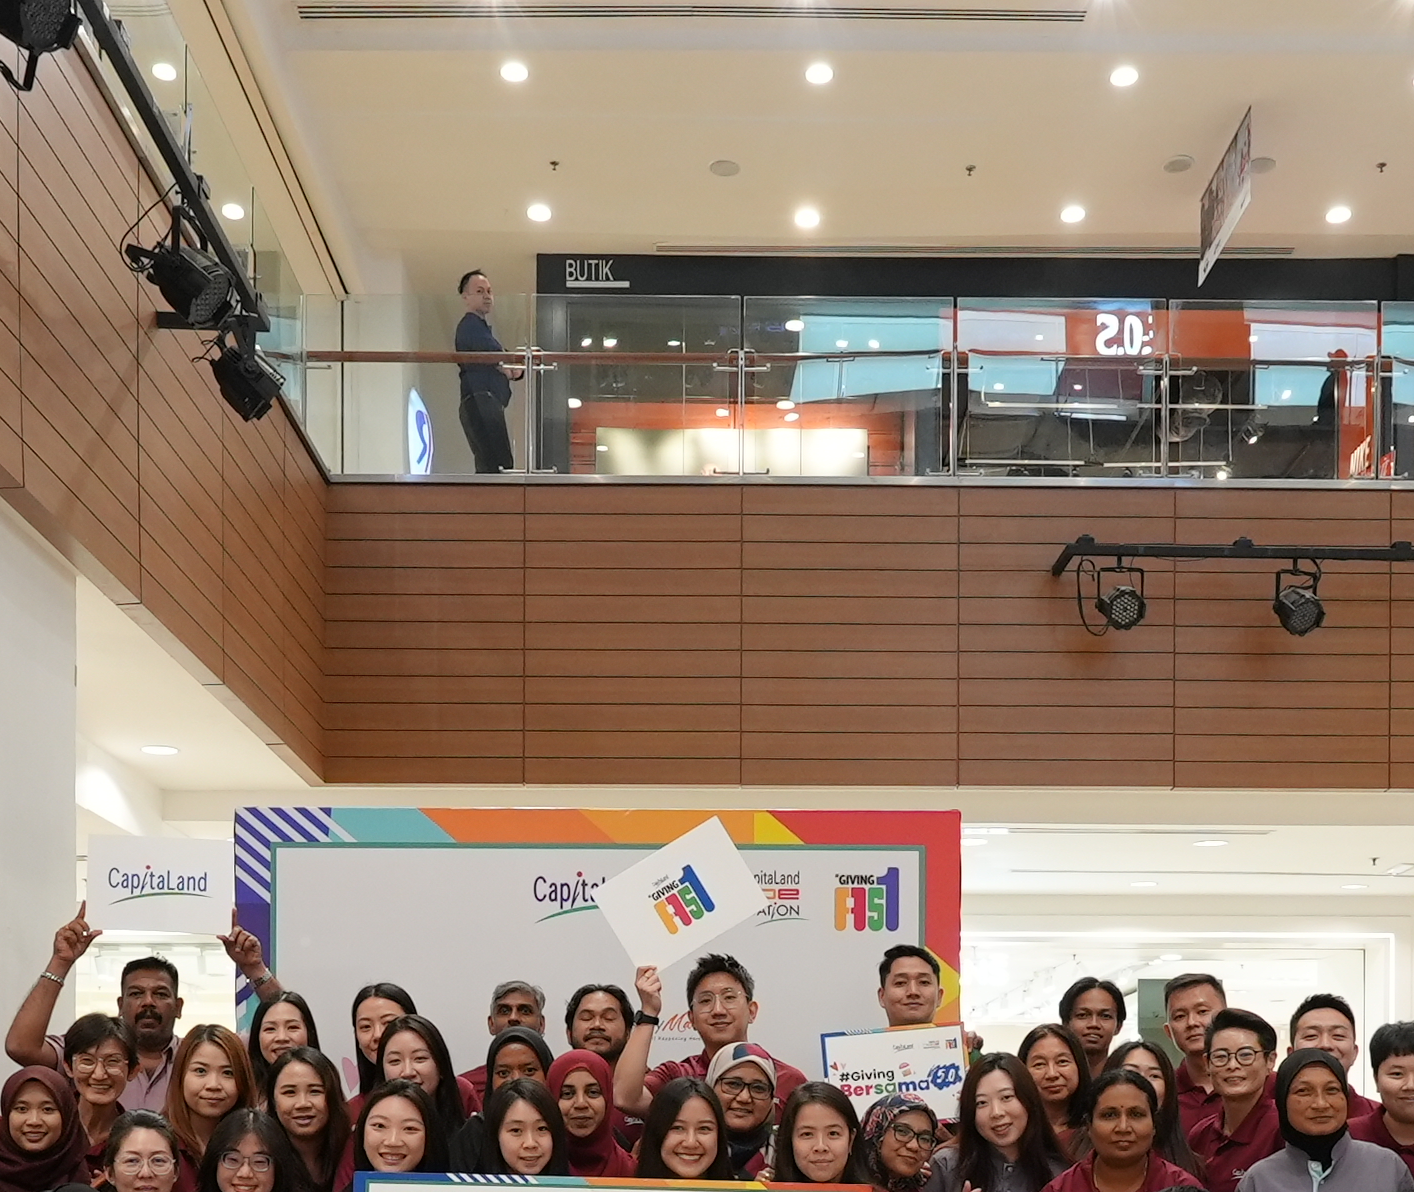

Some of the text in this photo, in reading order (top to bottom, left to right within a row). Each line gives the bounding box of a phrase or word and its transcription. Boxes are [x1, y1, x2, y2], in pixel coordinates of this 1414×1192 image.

[566, 259, 614, 281] BUTIK
[108, 864, 207, 894] CapitaLand
[753, 869, 800, 885] pitaLand
[533, 871, 606, 909] Capit
[756, 901, 800, 919] ATION
[839, 1068, 895, 1083] #Giving
[840, 1078, 930, 1098] Bersama
